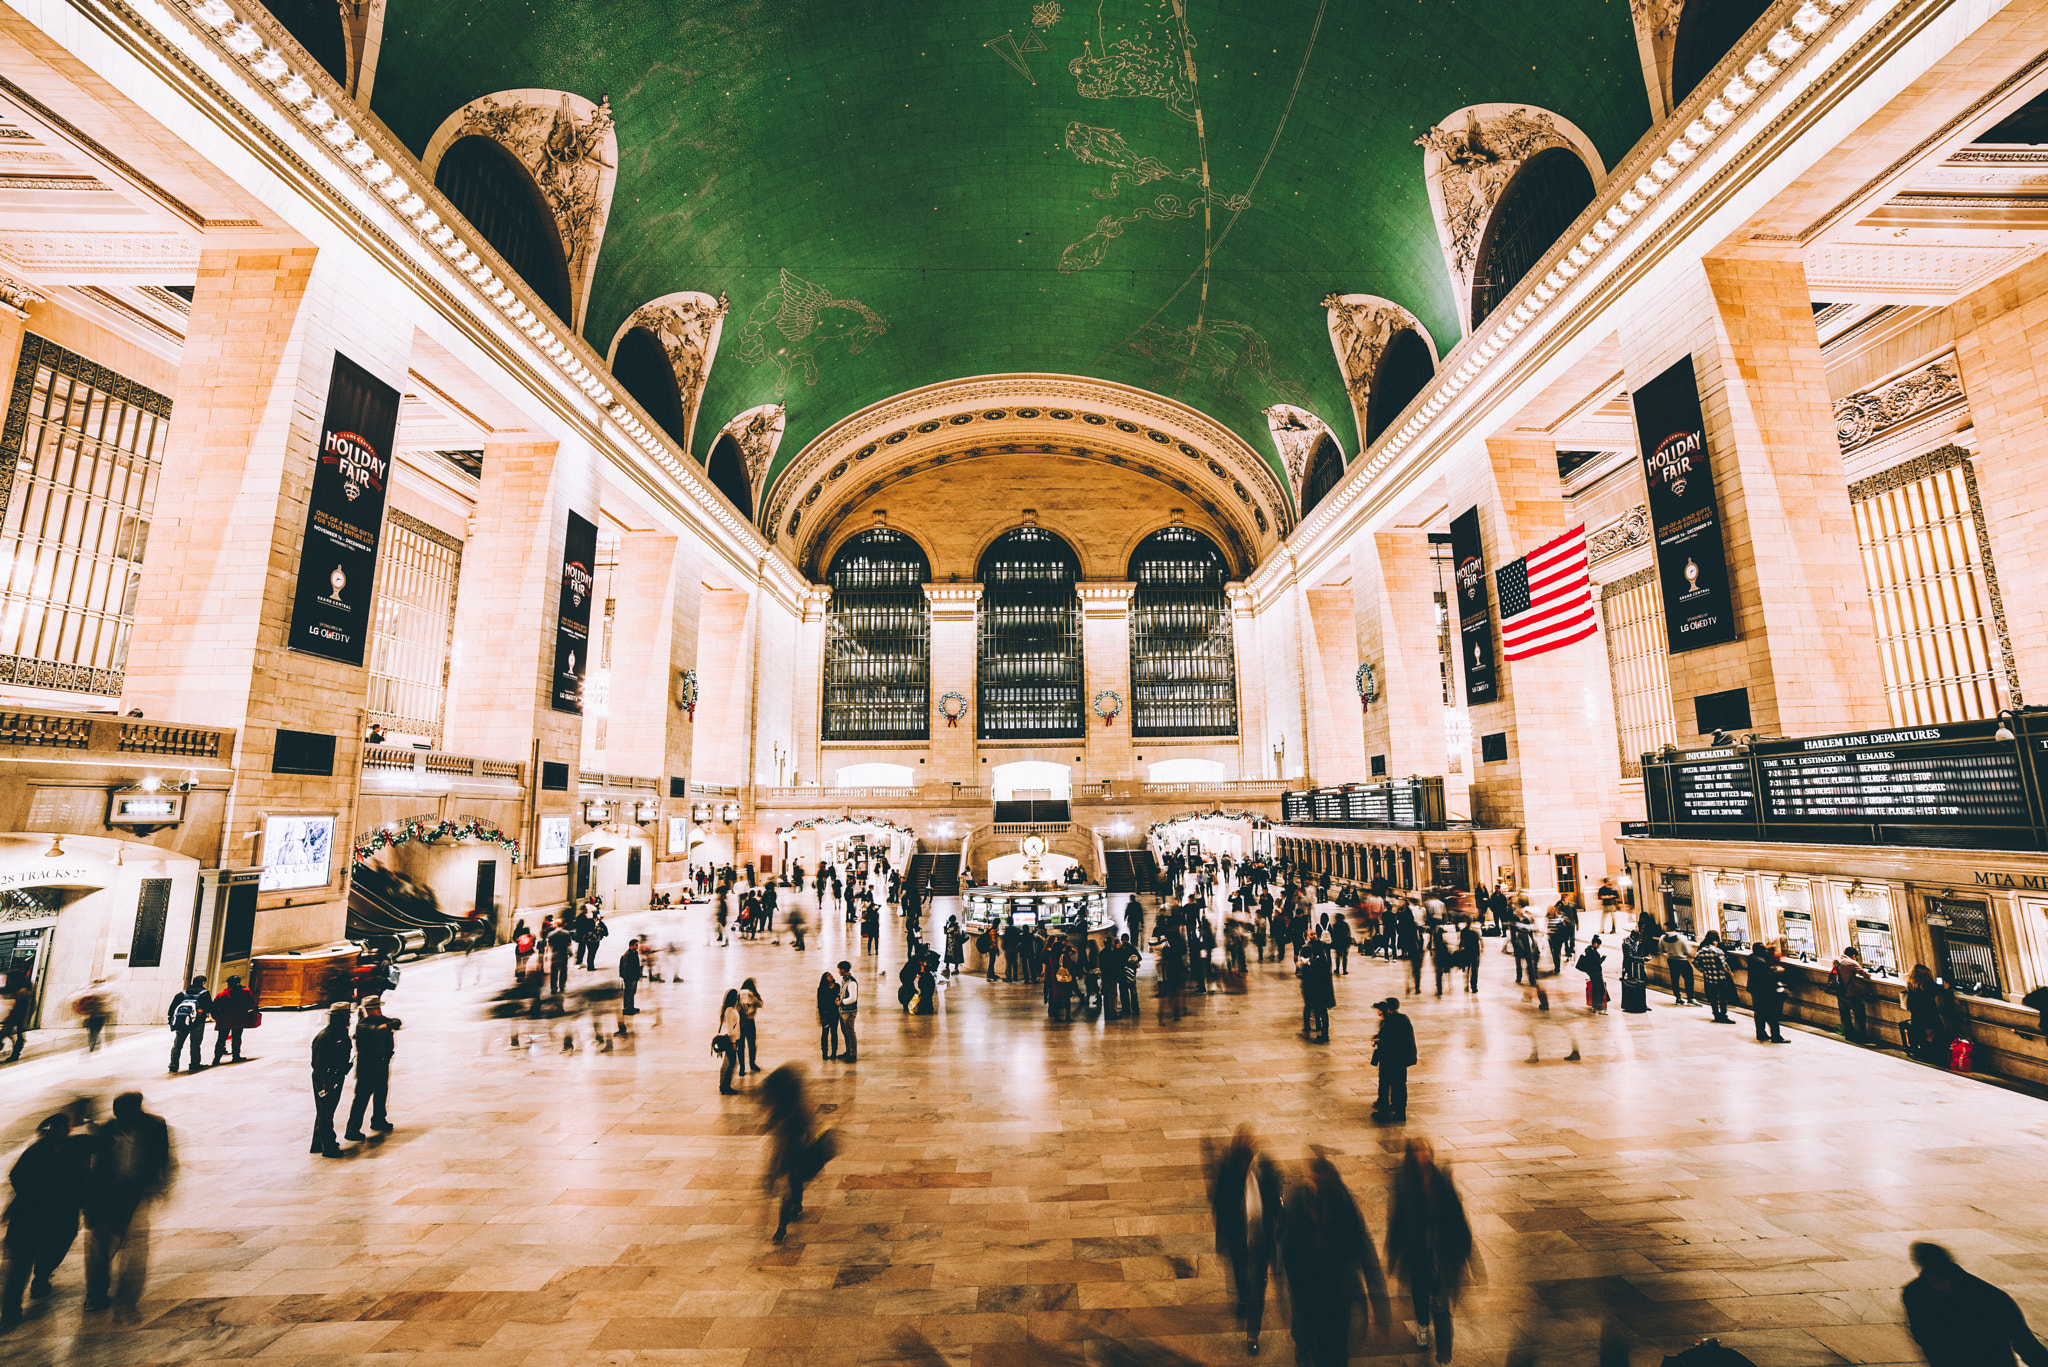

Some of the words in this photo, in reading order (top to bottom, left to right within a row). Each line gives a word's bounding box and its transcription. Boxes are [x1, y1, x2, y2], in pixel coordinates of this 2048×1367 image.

[325, 430, 386, 479] HOLIDAY
[1646, 430, 1701, 477] HOLIDAY
[339, 457, 370, 489] FAIR
[1662, 456, 1693, 482] FAIR
[1695, 505, 1711, 518] GIFTS
[313, 515, 326, 525] FOR
[327, 520, 343, 532] YOUR
[343, 528, 363, 541] ENTIRE
[363, 536, 375, 546] LIST
[1658, 530, 1669, 538] FOR
[1668, 524, 1683, 534] YOUR
[1683, 516, 1702, 528] ENTIRE
[1701, 510, 1713, 520] LIST
[313, 524, 338, 539] NOVEMBER
[345, 537, 366, 551] DECEMBER
[358, 529, 373, 540] GIFTS
[1660, 534, 1680, 546] NOVEMBER
[1687, 522, 1707, 535] DECEMBER
[565, 562, 592, 590] HOLIDAY
[1456, 557, 1482, 583] HOLIDAY
[570, 579, 586, 597] FAIR
[1463, 573, 1479, 589] FAIR
[317, 595, 332, 604] GRAND
[332, 600, 351, 610] CENTRAL
[1679, 592, 1693, 601] GRAND
[1692, 588, 1710, 597] CENTRAL
[1680, 623, 1690, 632] LG
[1690, 619, 1709, 630] OLED
[1707, 616, 1717, 626] TV
[309, 625, 319, 636] LG
[320, 628, 341, 641] OLED
[341, 633, 351, 644] TV
[1804, 738, 1844, 750] HARLEM
[1844, 736, 1868, 747] LINE
[1870, 729, 1941, 744] DEPARTURES
[1685, 749, 1734, 760] INFORMATION
[1762, 759, 1779, 768] TIME
[1781, 758, 1797, 767] TRK
[1799, 755, 1847, 765] DESTINATION
[1856, 751, 1895, 761] REMARKS
[1859, 763, 1891, 772] DEPARTED
[1812, 777, 1830, 785] WHITE
[1831, 776, 1853, 784] PLAINS
[1860, 774, 1889, 782] MELROSE
[1899, 773, 1911, 781] 1ST
[1913, 772, 1932, 781] STOP
[1804, 787, 1835, 795] SOUTHEAST
[1862, 784, 1902, 793] CONNECTION
[1903, 784, 1913, 793] TO
[1915, 783, 1947, 792] WASSAIC
[1815, 797, 1833, 805] WHITE
[1834, 797, 1857, 805] PLAINS
[1902, 795, 1915, 803] 1ST
[1917, 795, 1936, 803] STOP
[1865, 807, 1887, 815] WHITE
[1887, 806, 1913, 815] PLAINS
[1924, 806, 1937, 815] 1ST
[1939, 806, 1959, 815] STOP
[405, 812, 438, 826] BUILDING
[19, 869, 71, 882] TRACKS
[1974, 871, 2015, 887] MTA
